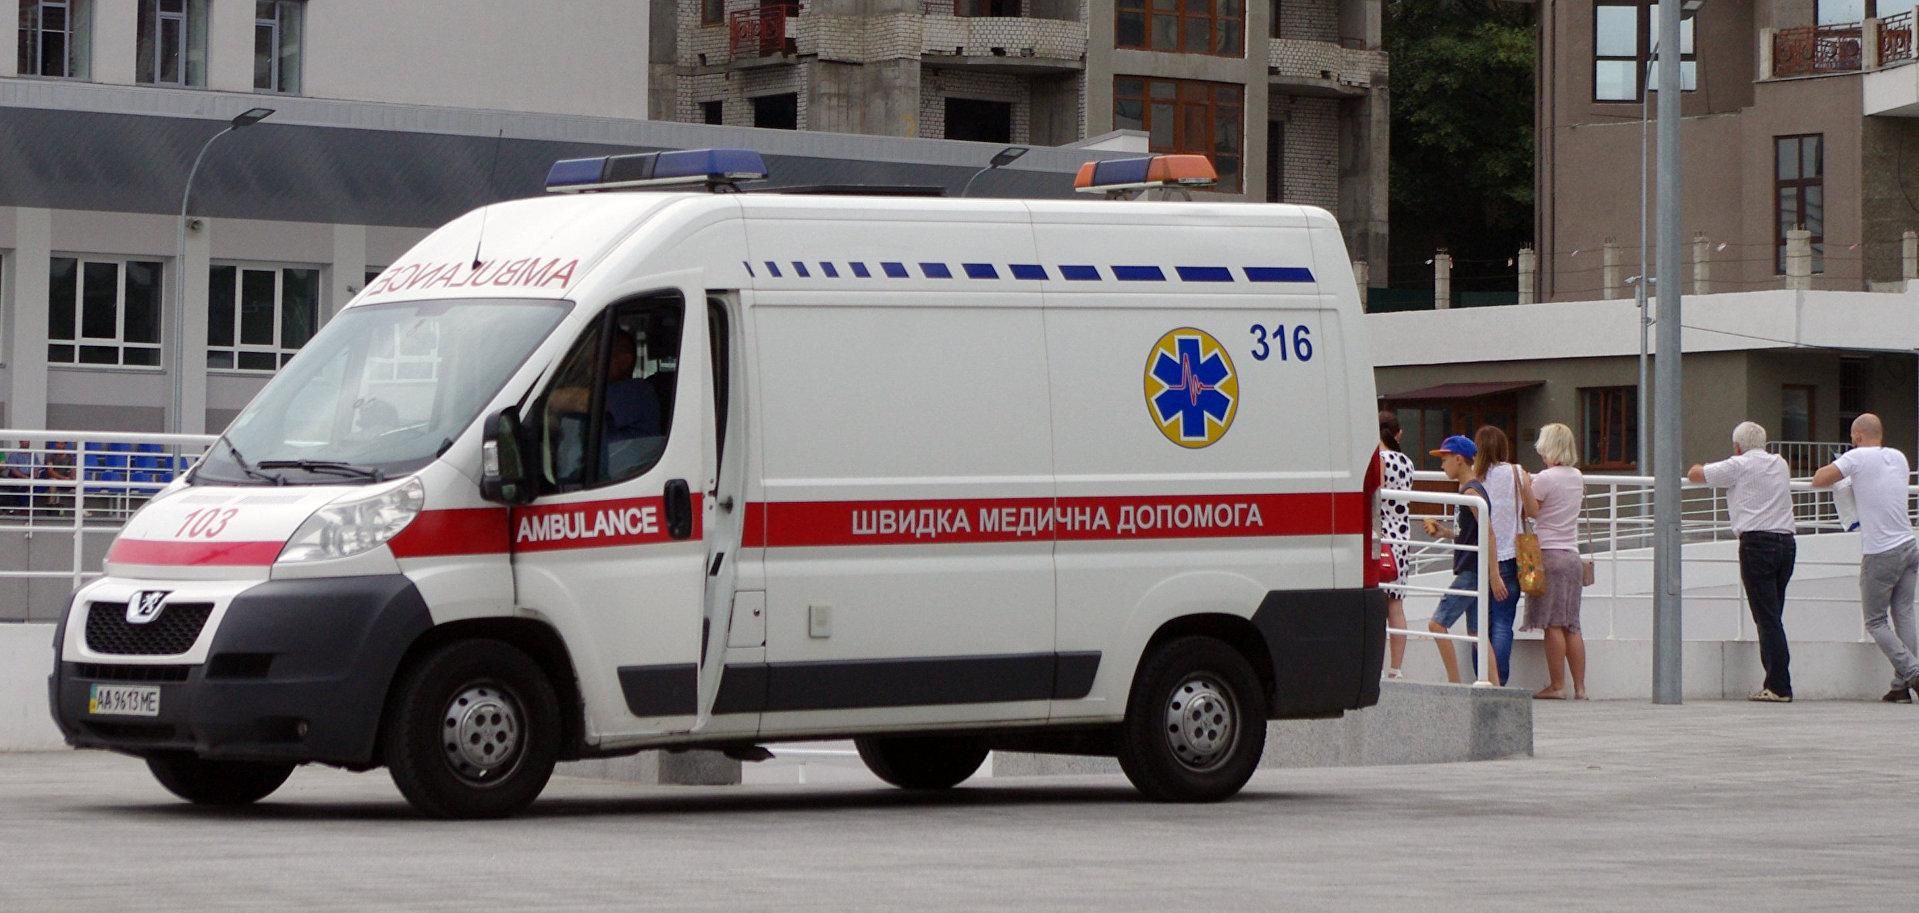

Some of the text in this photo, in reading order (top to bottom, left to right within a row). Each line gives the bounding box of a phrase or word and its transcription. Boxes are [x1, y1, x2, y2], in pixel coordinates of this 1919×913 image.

[1249, 323, 1313, 362] 316
[175, 507, 239, 538] 103
[516, 506, 659, 543] AMBULANCE
[851, 503, 1264, 538] ШВИДКА МЕДИЧНА ДОПОМОГА
